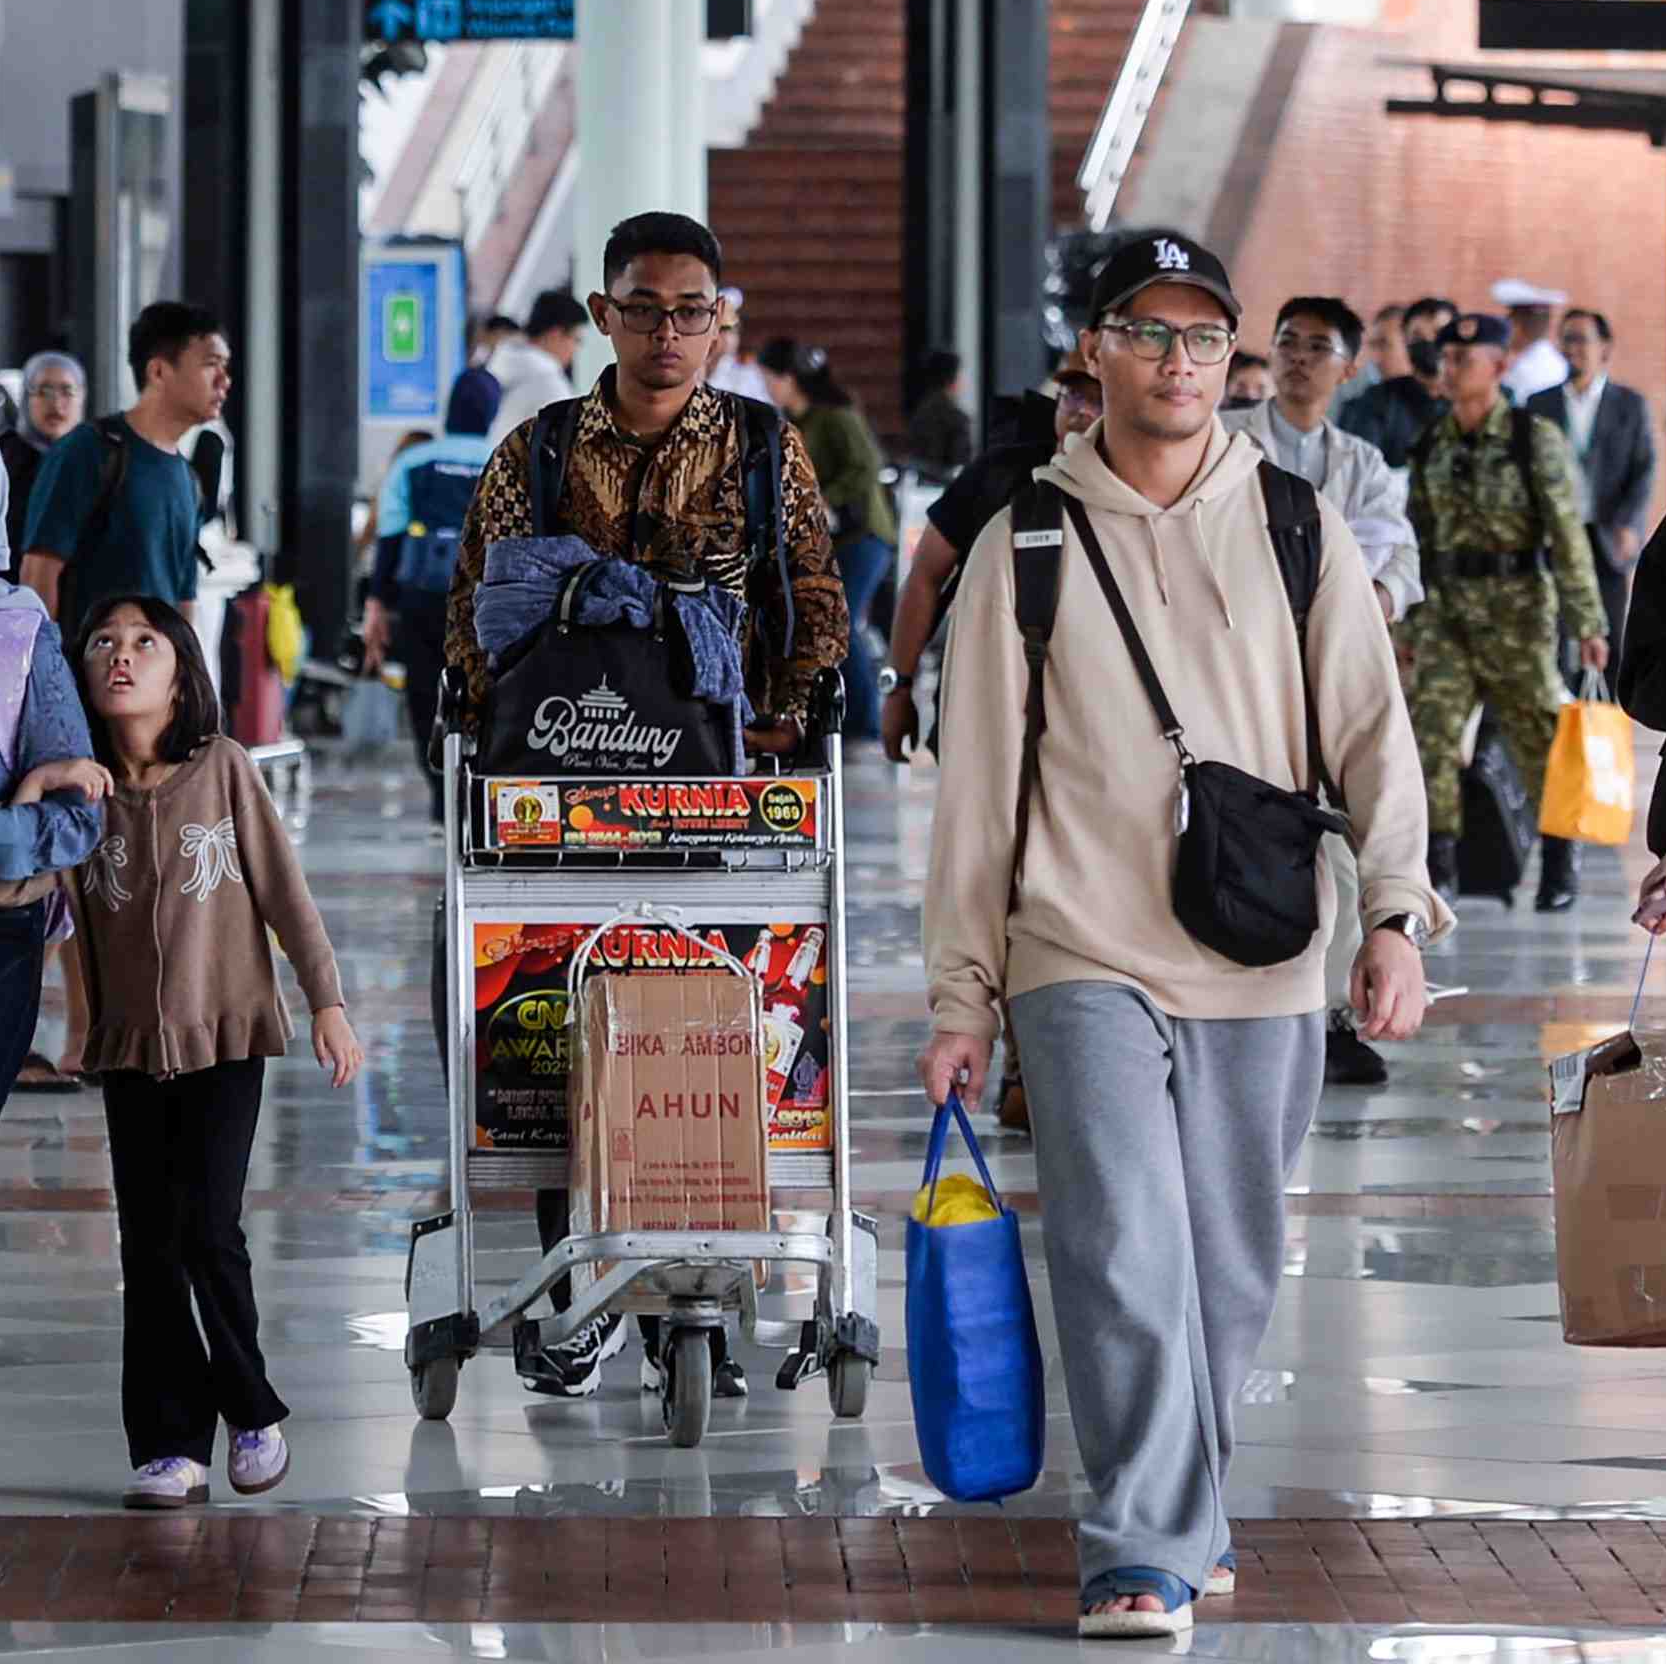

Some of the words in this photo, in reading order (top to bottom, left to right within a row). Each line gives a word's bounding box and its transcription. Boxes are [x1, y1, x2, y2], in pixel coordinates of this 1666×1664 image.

[1153, 238, 1189, 270] LA
[526, 695, 683, 768] Bandung
[618, 783, 752, 817] KURNIA
[573, 928, 731, 968] KURNIA
[615, 1031, 665, 1057] BIKA
[681, 1031, 761, 1057] AMBON
[636, 1092, 741, 1120] AHUN
